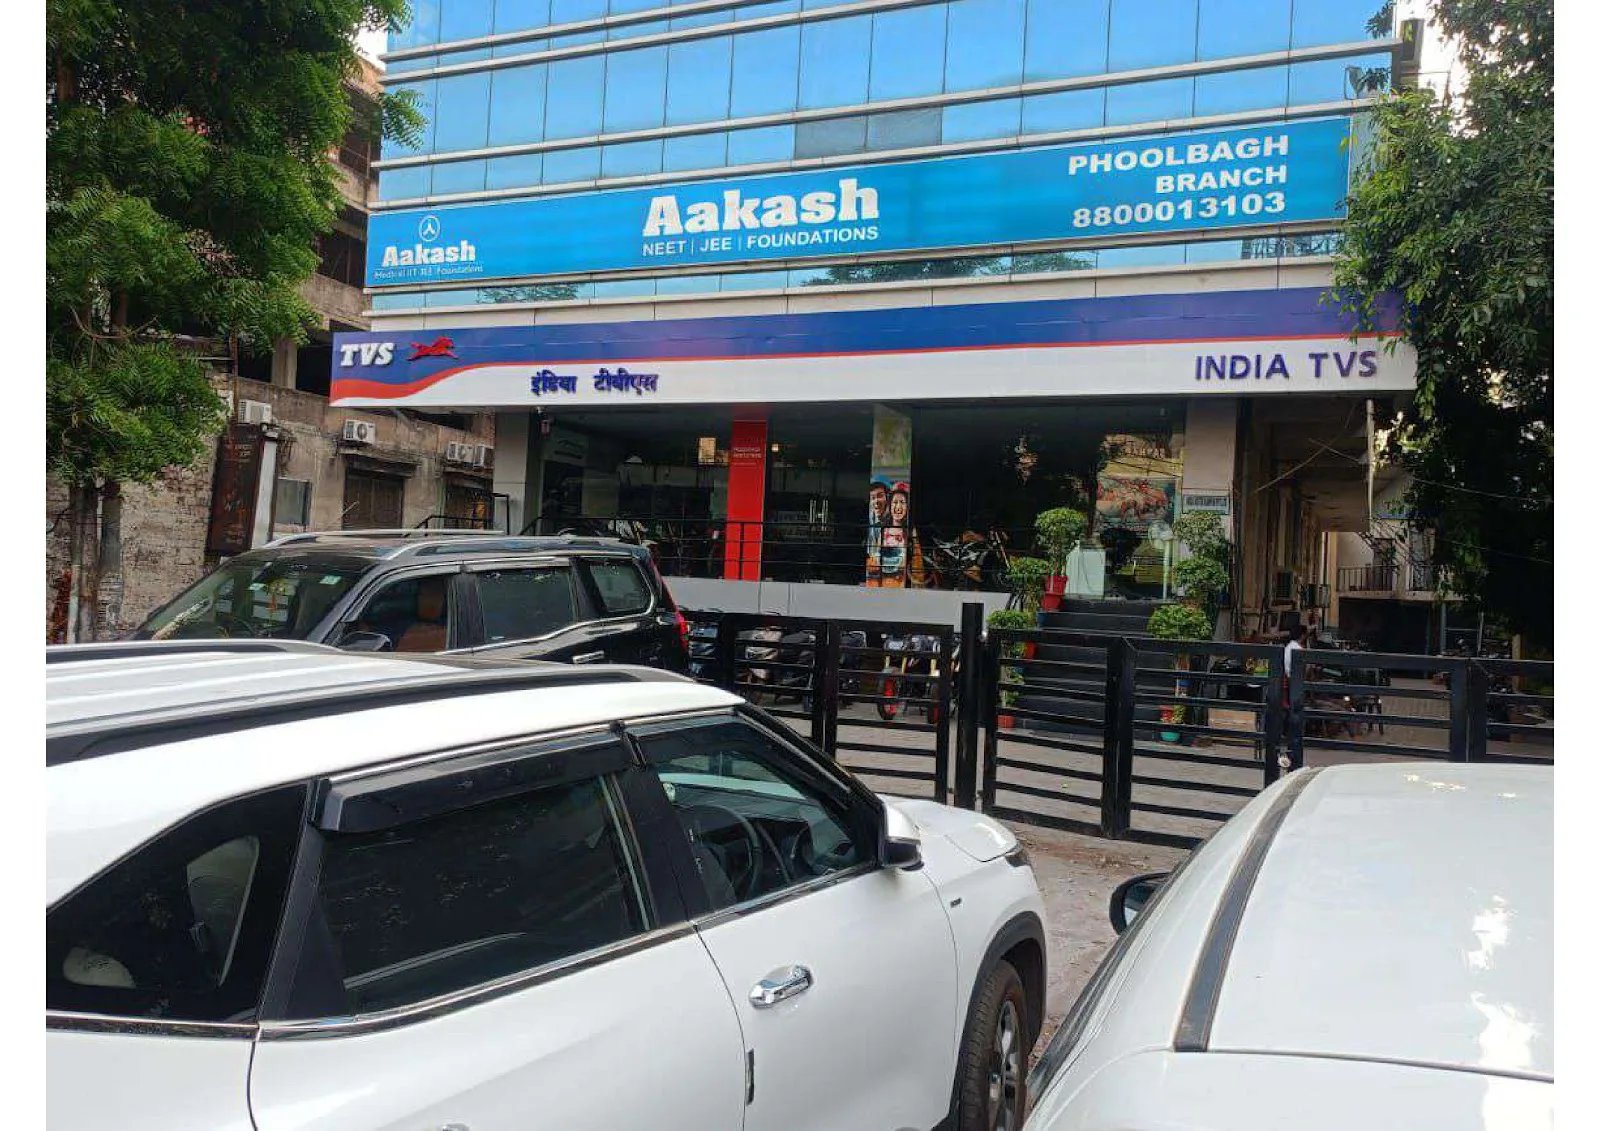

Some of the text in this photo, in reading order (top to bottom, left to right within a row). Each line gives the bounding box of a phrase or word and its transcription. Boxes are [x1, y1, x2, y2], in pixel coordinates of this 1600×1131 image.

[1068, 134, 1290, 176] PHOOLBAGH
[1155, 164, 1288, 195] BRANCH
[642, 178, 880, 237] Aakash
[1072, 191, 1287, 228] 8800013103
[381, 239, 477, 268] Aakash
[642, 226, 880, 257] NEET JEE FOUNDATIONS
[340, 342, 395, 367] TVS
[1194, 350, 1379, 381] INDIA TVS
